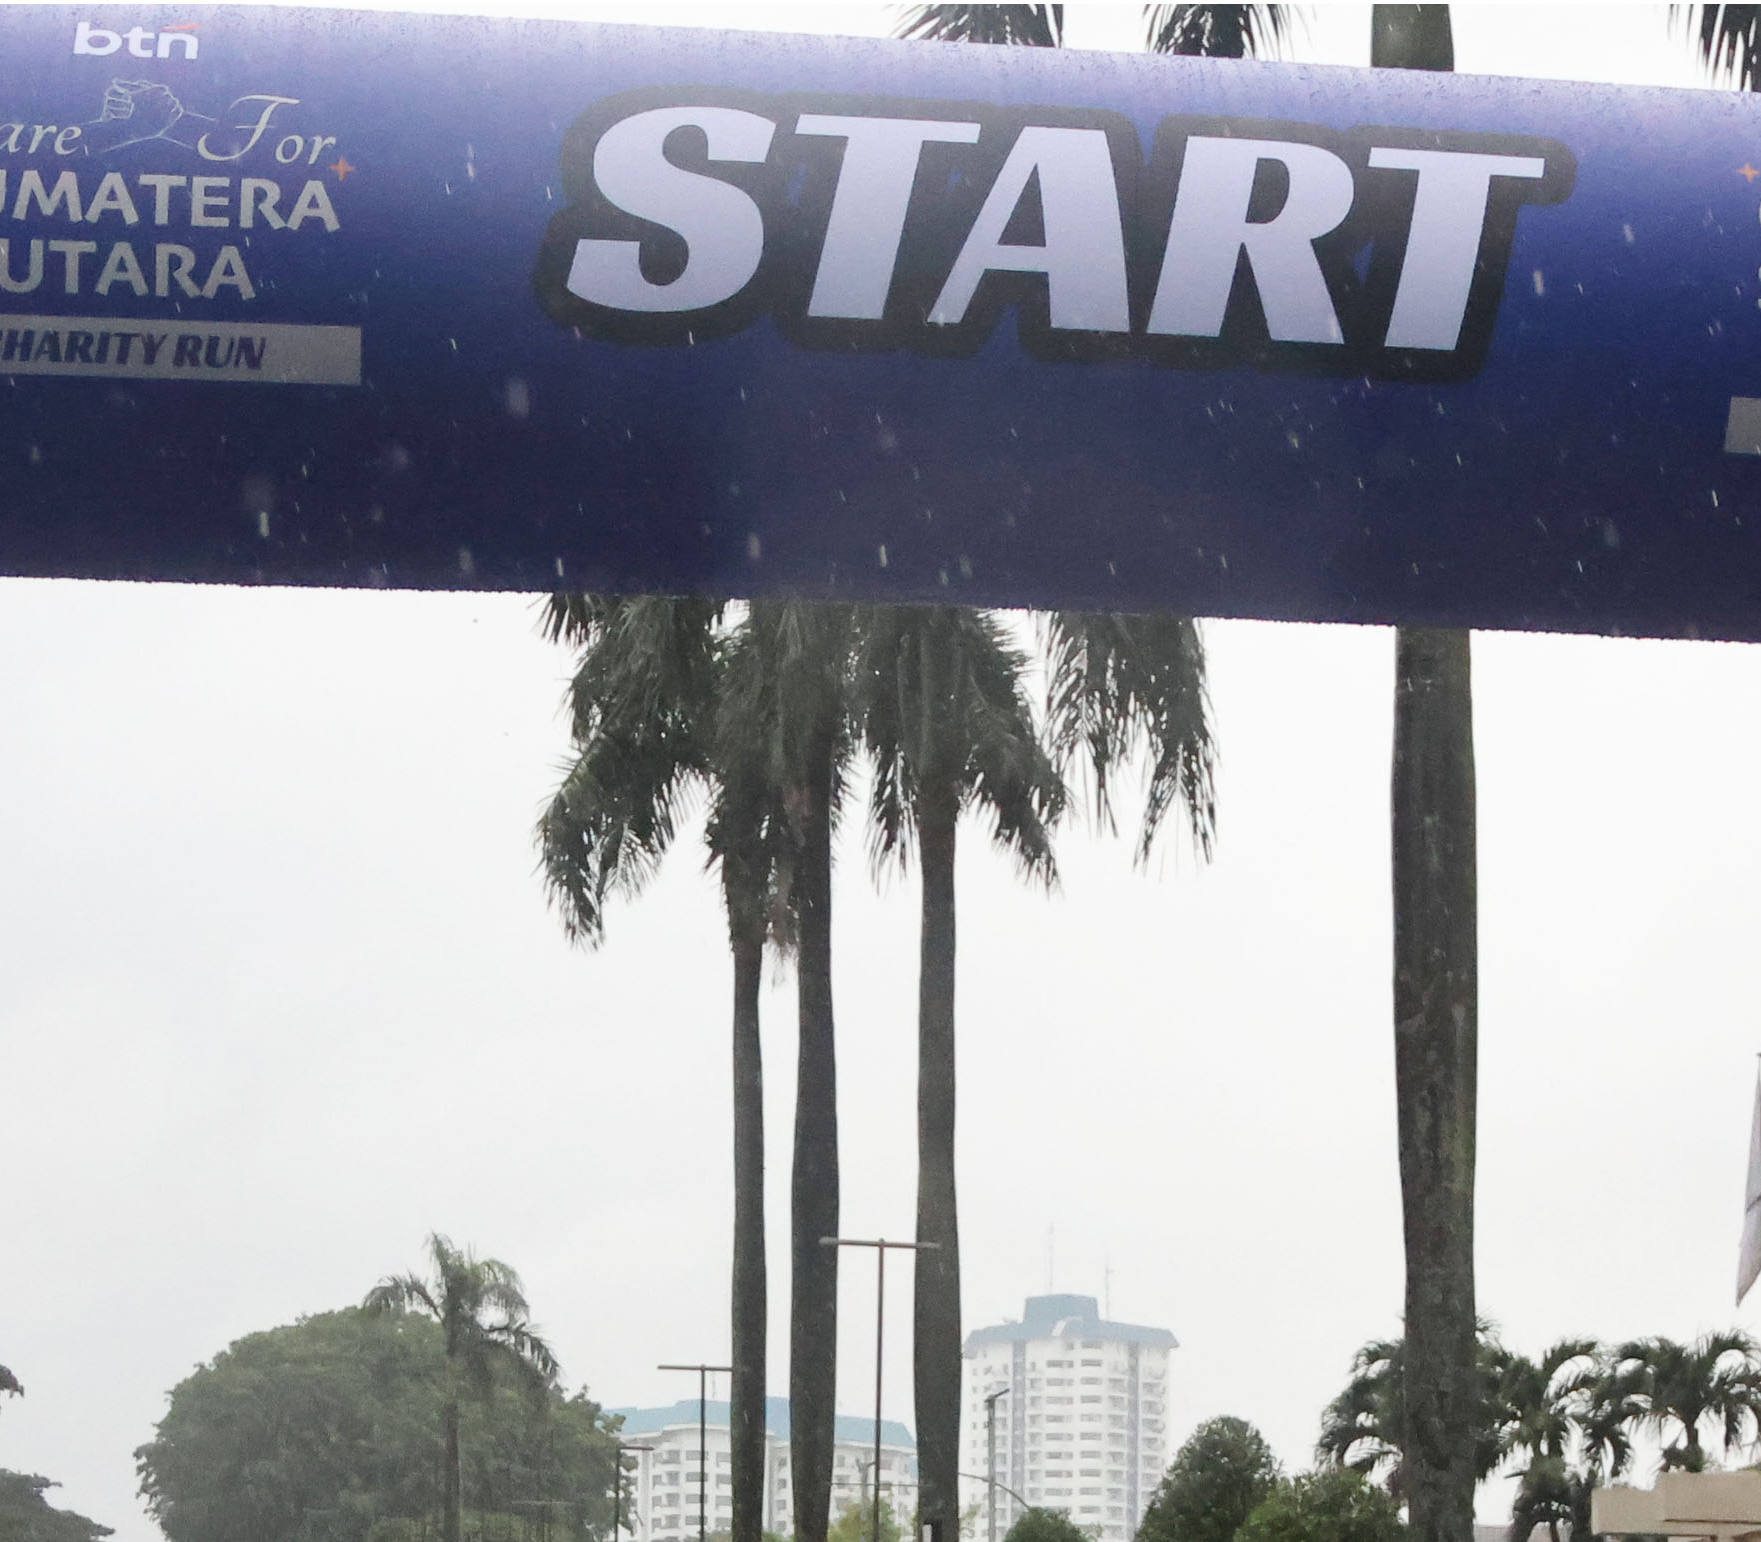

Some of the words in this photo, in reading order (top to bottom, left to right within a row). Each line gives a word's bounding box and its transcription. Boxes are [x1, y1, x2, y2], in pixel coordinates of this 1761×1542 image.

[73, 22, 200, 60] btn
[197, 95, 337, 165] For
[566, 105, 1545, 352] START
[172, 333, 267, 371] RUN
